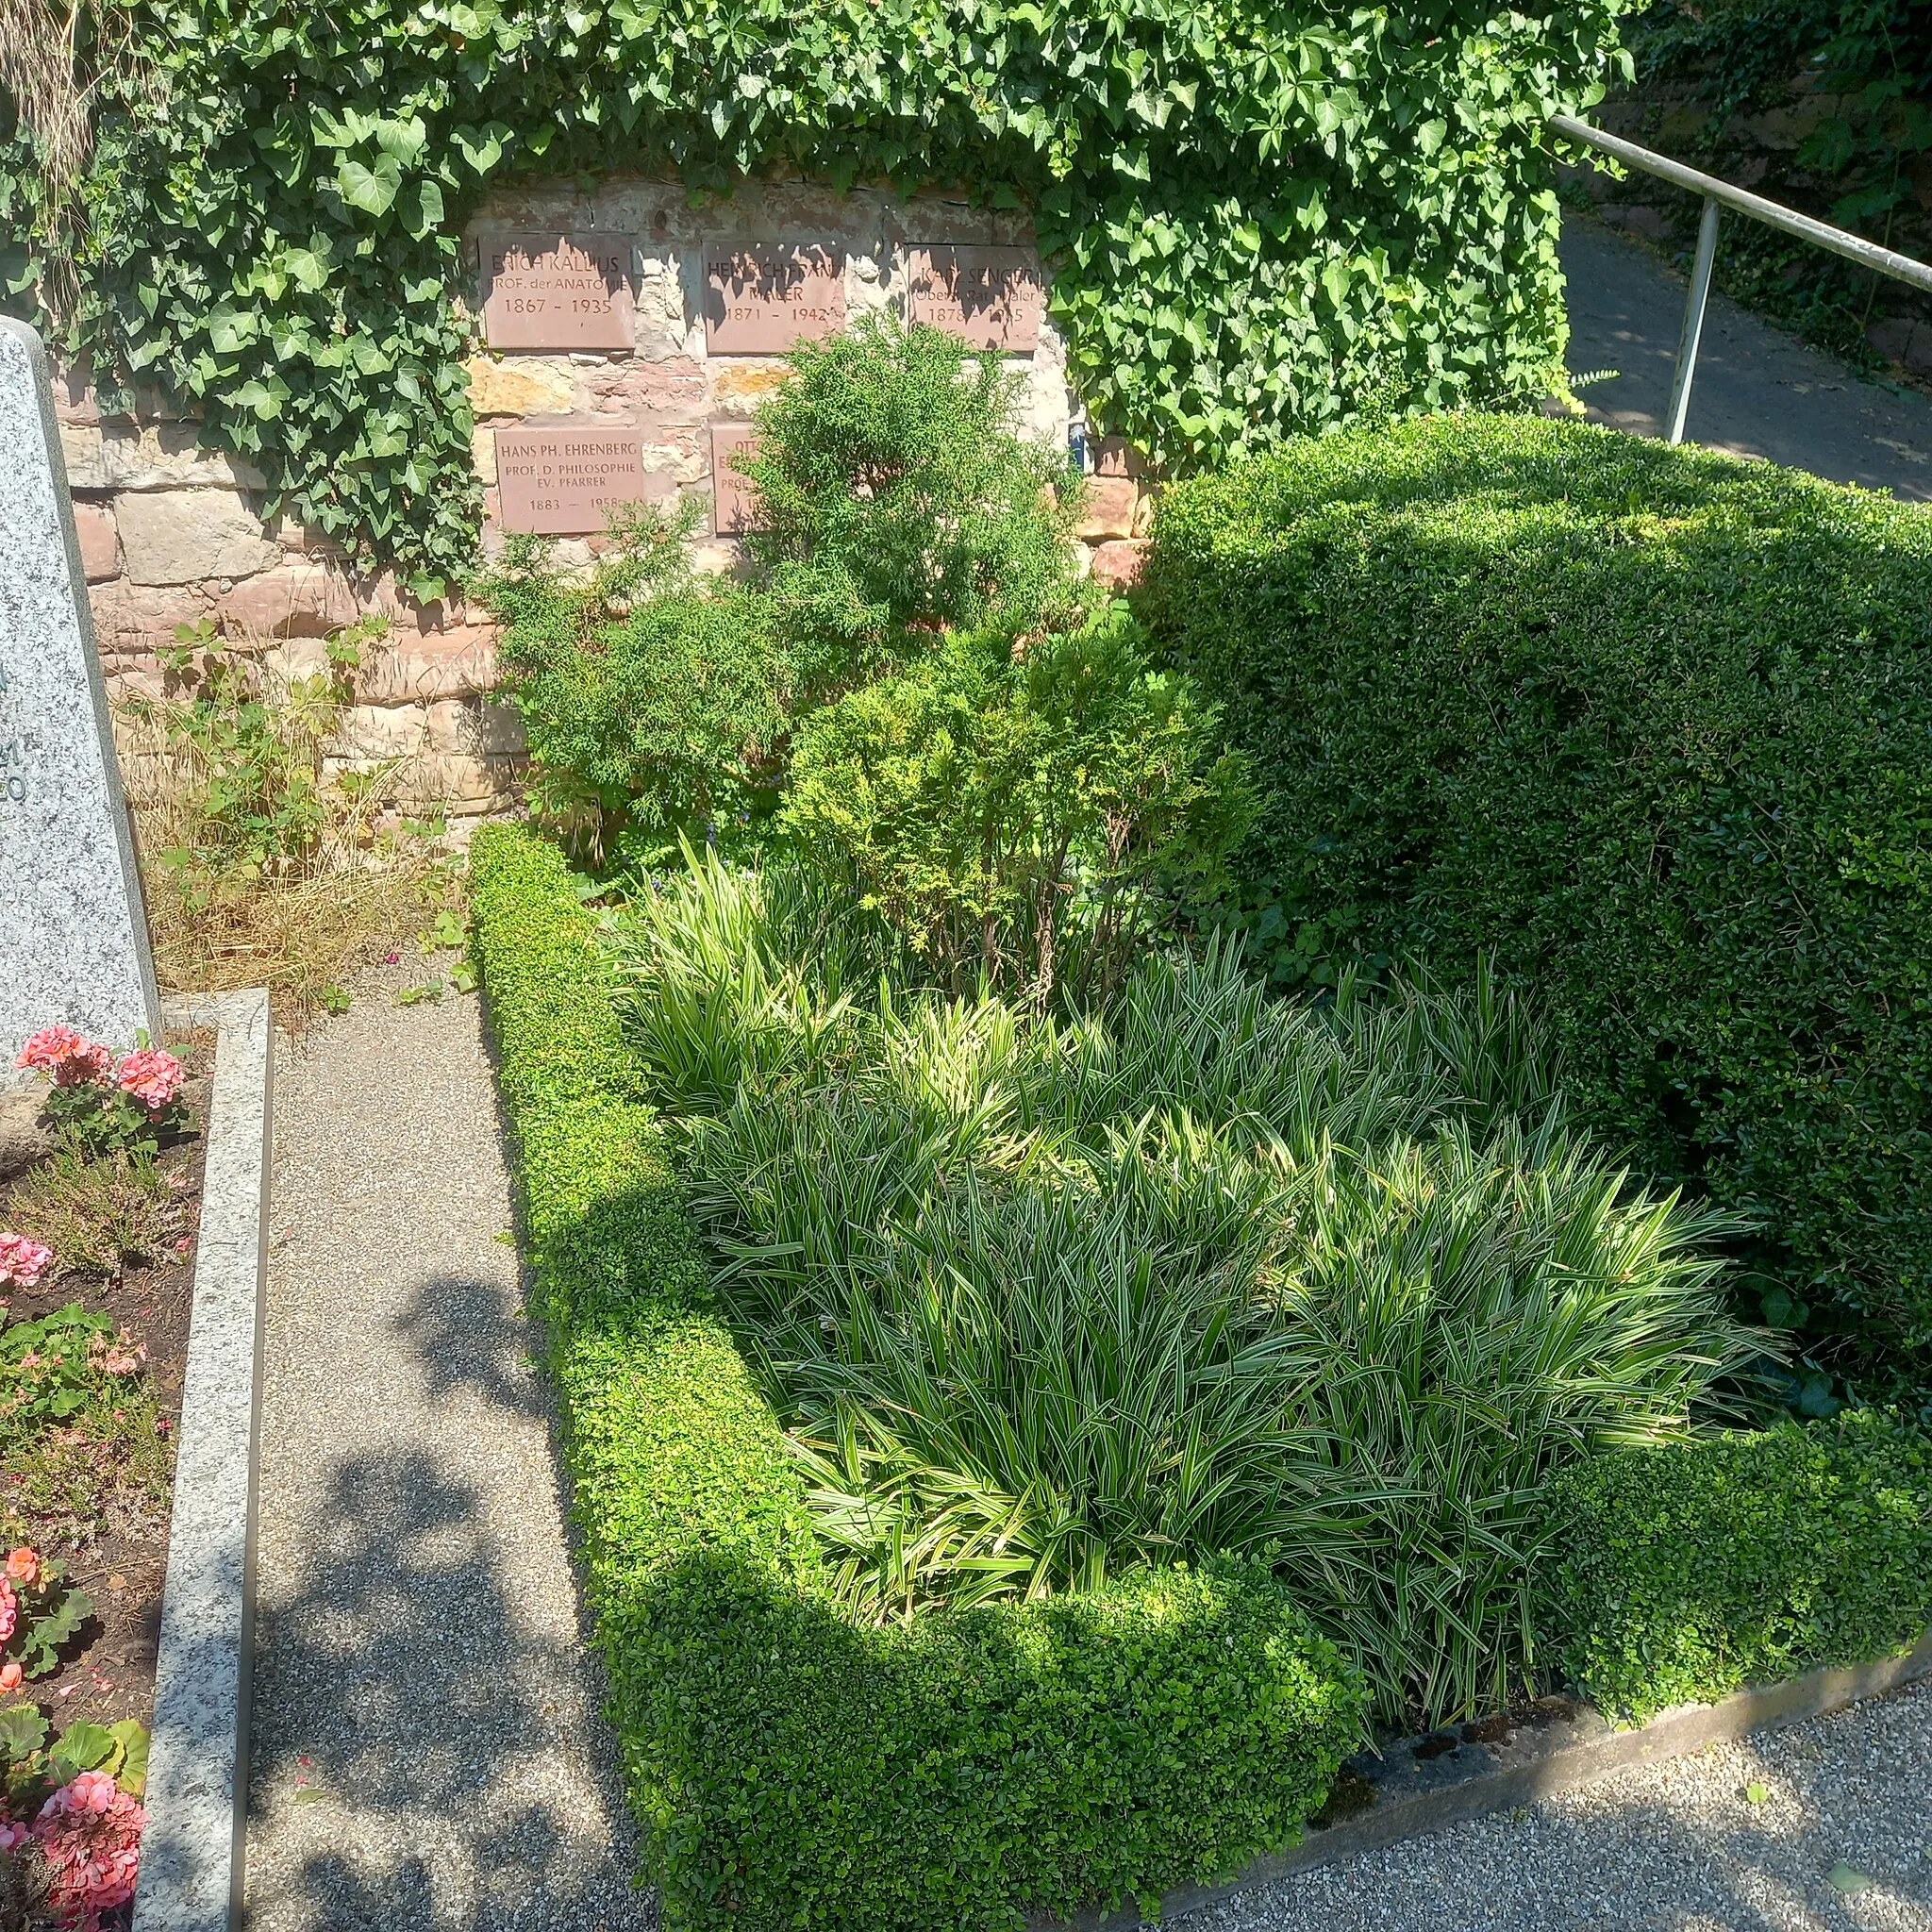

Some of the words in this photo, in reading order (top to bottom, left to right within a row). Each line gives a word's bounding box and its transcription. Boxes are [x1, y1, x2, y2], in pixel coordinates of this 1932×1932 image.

[492, 255, 544, 271] ERICH
[549, 256, 619, 272] KALLIUS
[968, 267, 1032, 285] SENGER
[488, 277, 527, 290] PROF.
[530, 277, 552, 290] der
[555, 278, 627, 291] ANATOMIE
[749, 286, 803, 301] MALER
[505, 299, 546, 313] 1867
[572, 299, 612, 314] 1935
[727, 308, 761, 321] 1871
[792, 308, 826, 322] 1942
[929, 308, 965, 322] 1878
[502, 444, 537, 458] HANS
[541, 444, 561, 458] PH.
[565, 442, 637, 457] EHRENBERG
[506, 465, 540, 476] PROF.
[542, 464, 555, 475] D.
[558, 463, 636, 475] PHILOSOPHIE
[538, 477, 555, 489] EV.
[559, 476, 606, 488] PFARRER
[530, 499, 560, 511] 1883
[590, 497, 618, 509] 1958
